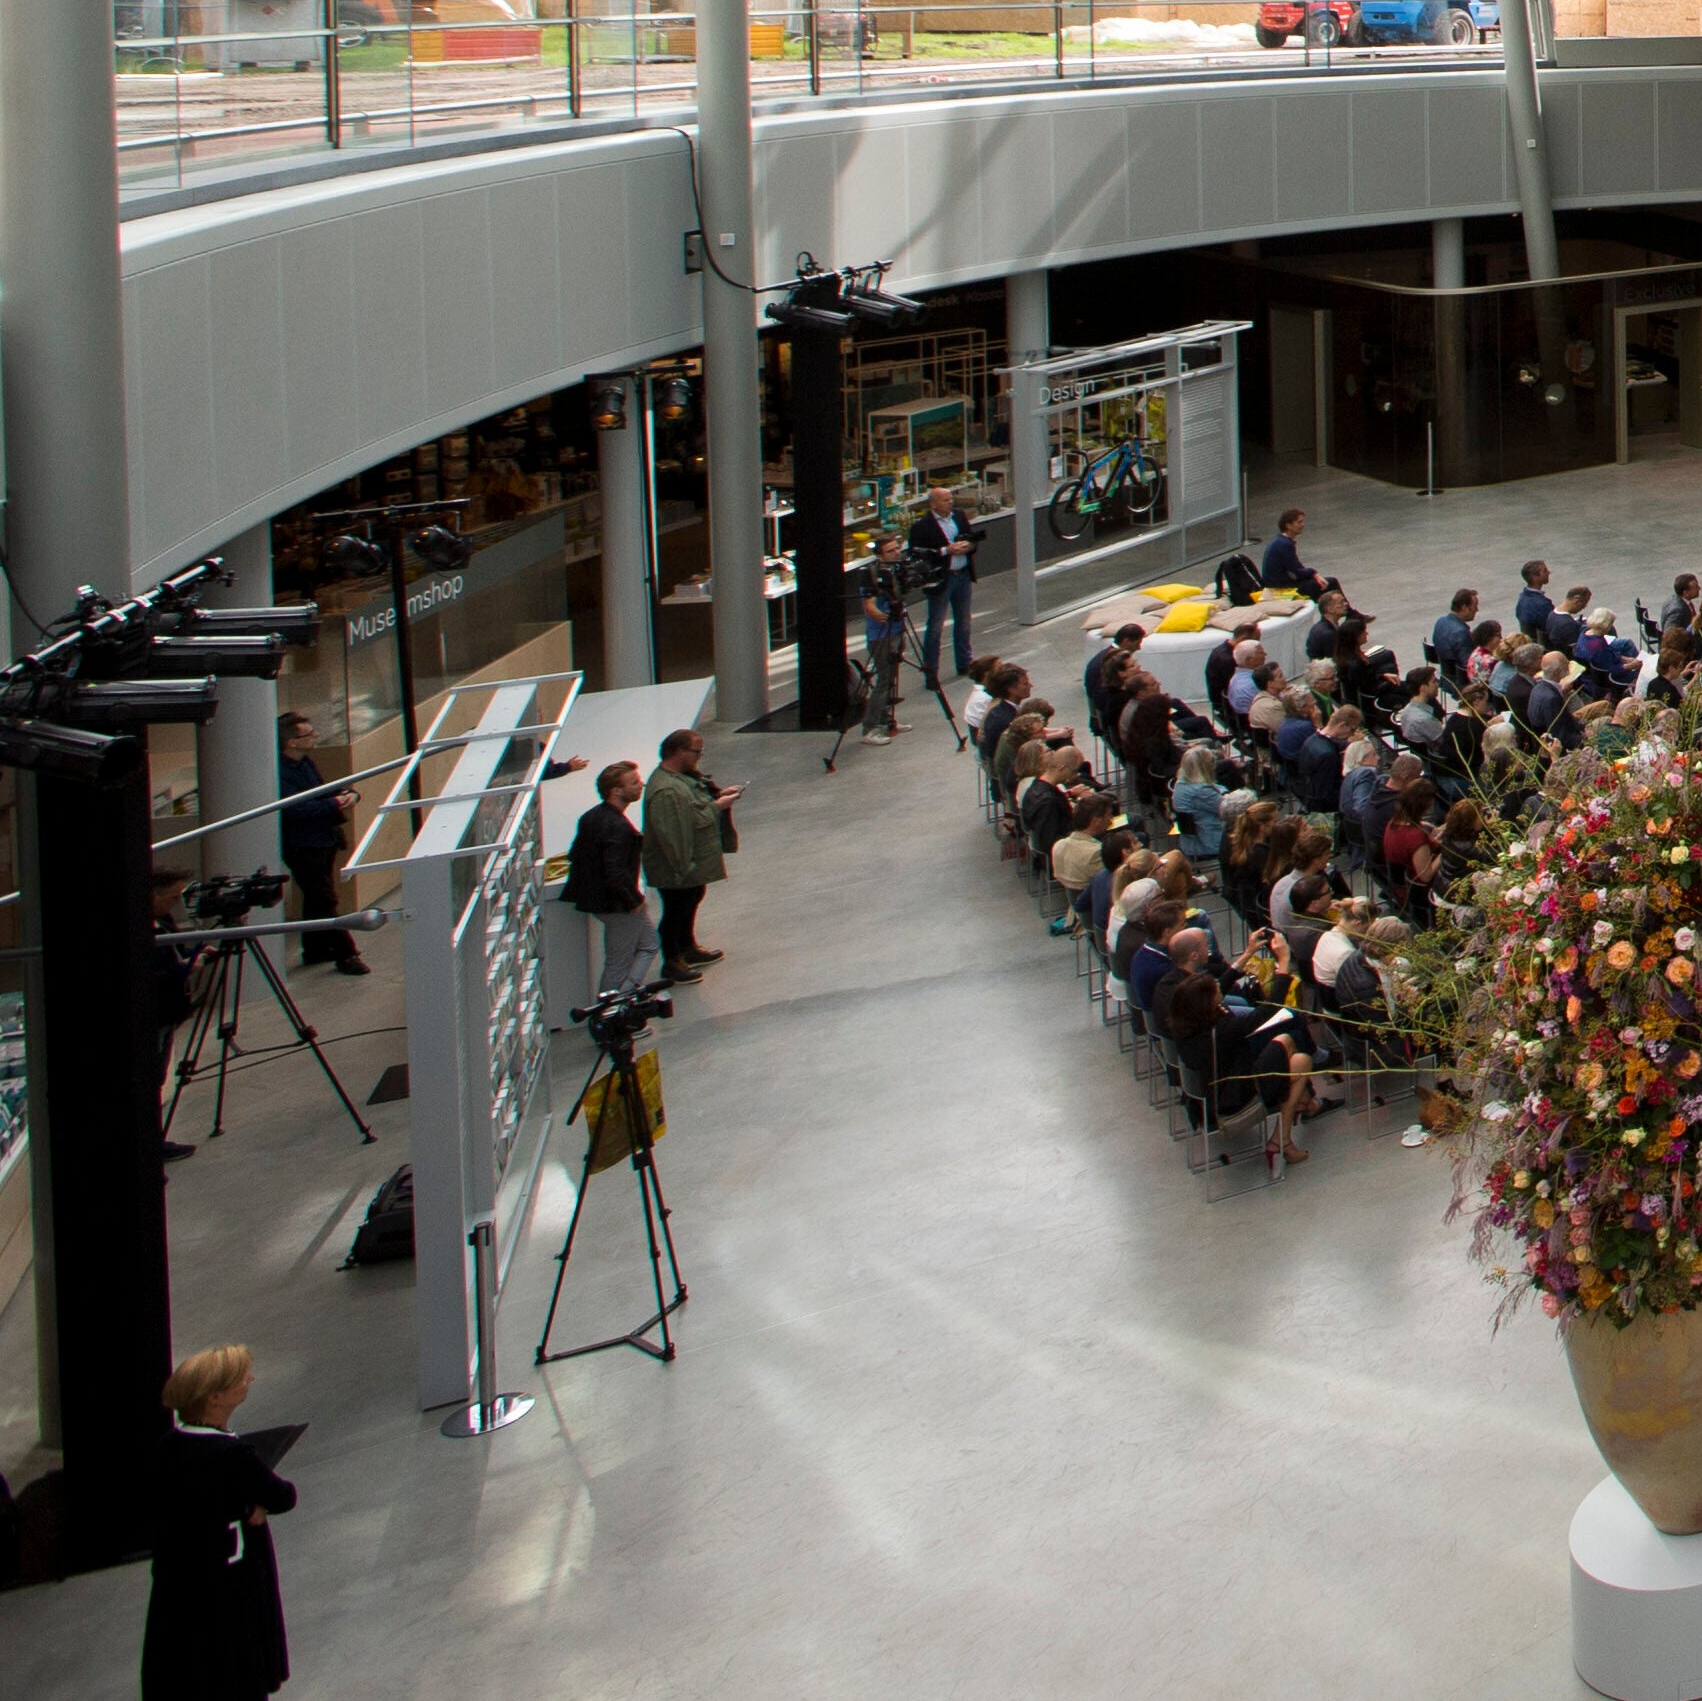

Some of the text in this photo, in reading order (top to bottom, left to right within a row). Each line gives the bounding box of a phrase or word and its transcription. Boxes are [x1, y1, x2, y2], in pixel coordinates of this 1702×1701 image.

[1625, 283, 1696, 300] Exclusive
[1040, 379, 1096, 405] Design
[348, 575, 464, 646] Musemshop
